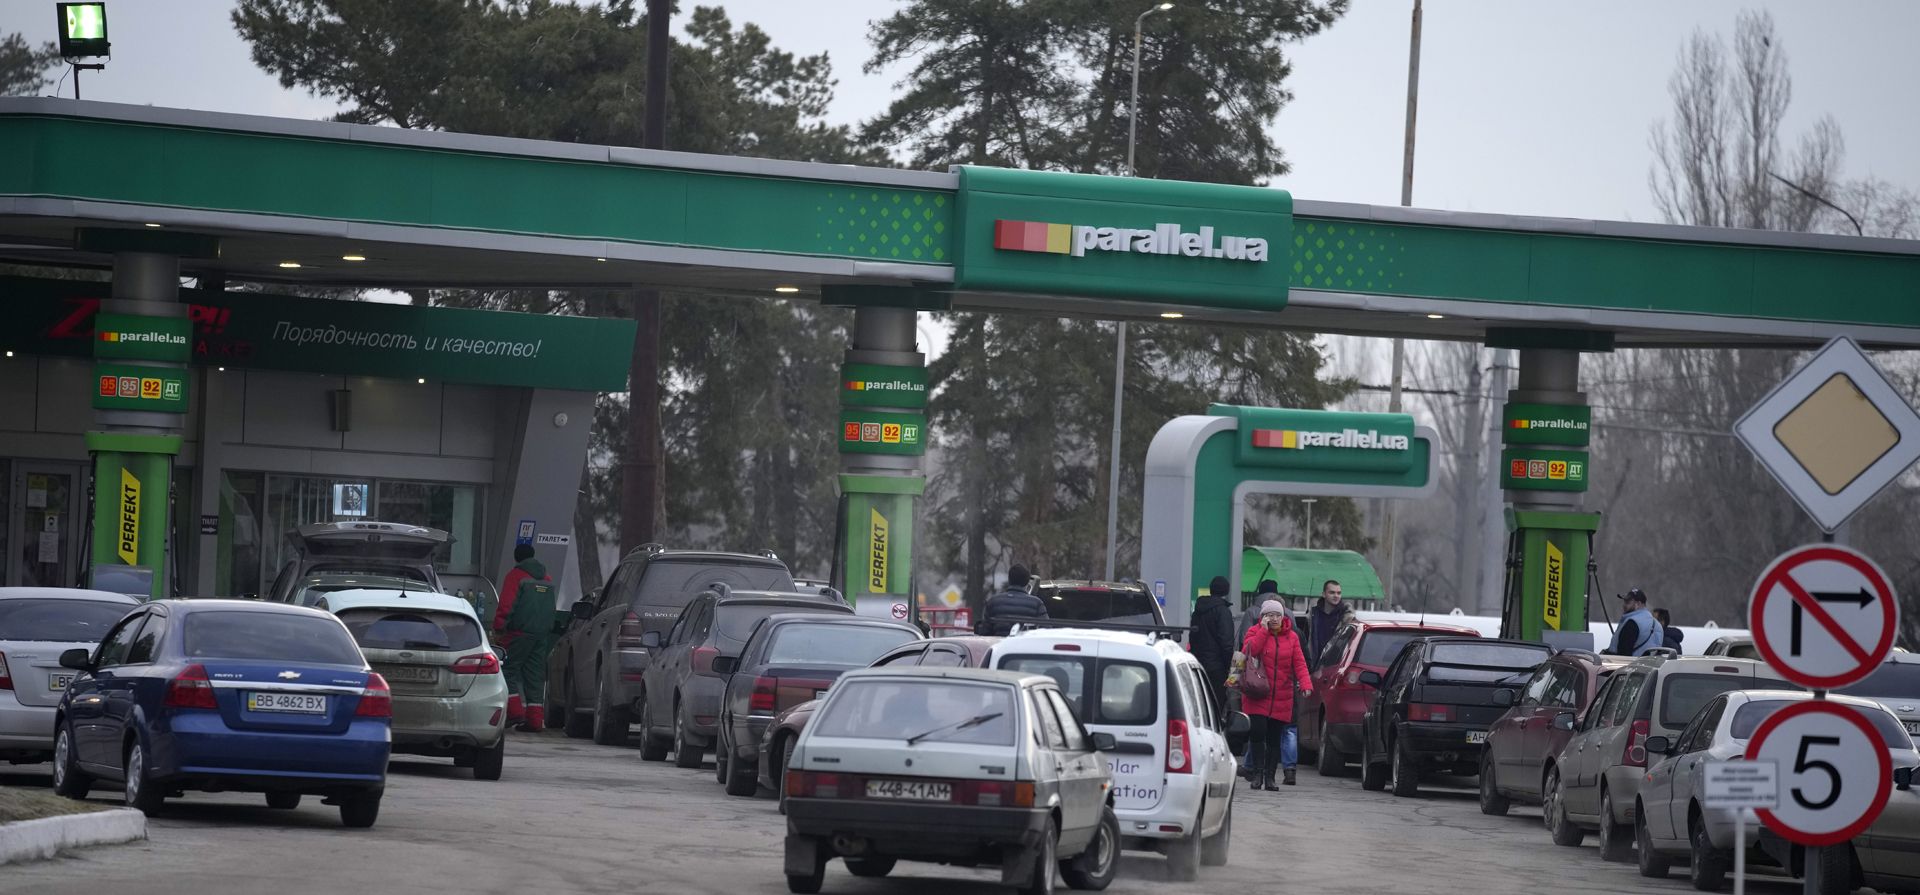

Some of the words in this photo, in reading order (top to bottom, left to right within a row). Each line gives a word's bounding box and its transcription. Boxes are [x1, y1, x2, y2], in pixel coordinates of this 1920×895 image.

[1071, 222, 1269, 262] parallel.ua
[119, 332, 186, 344] parallel.ua
[273, 320, 417, 350] Порядочность
[424, 336, 437, 351] и
[442, 336, 542, 359] качество!
[102, 378, 115, 390] 95
[122, 380, 136, 391] 95
[143, 381, 160, 392] 92
[165, 382, 180, 394] ДТ
[865, 381, 924, 391] parallel.ua
[846, 424, 859, 435] 95
[864, 425, 878, 436] 95
[884, 426, 899, 437] 92
[1530, 418, 1587, 430] parallel.ua
[1296, 428, 1409, 450] parallel.ua
[1531, 462, 1545, 473] 95
[1550, 463, 1565, 474] 92
[122, 484, 137, 553] PERFEKT
[538, 535, 561, 543] ТУАЛЕТ
[872, 523, 885, 588] PERFEKT
[1547, 556, 1561, 618] PERFEKT
[256, 695, 273, 707] BB
[277, 696, 303, 709] 4862
[306, 697, 323, 710] BX
[1790, 735, 1843, 811] 5
